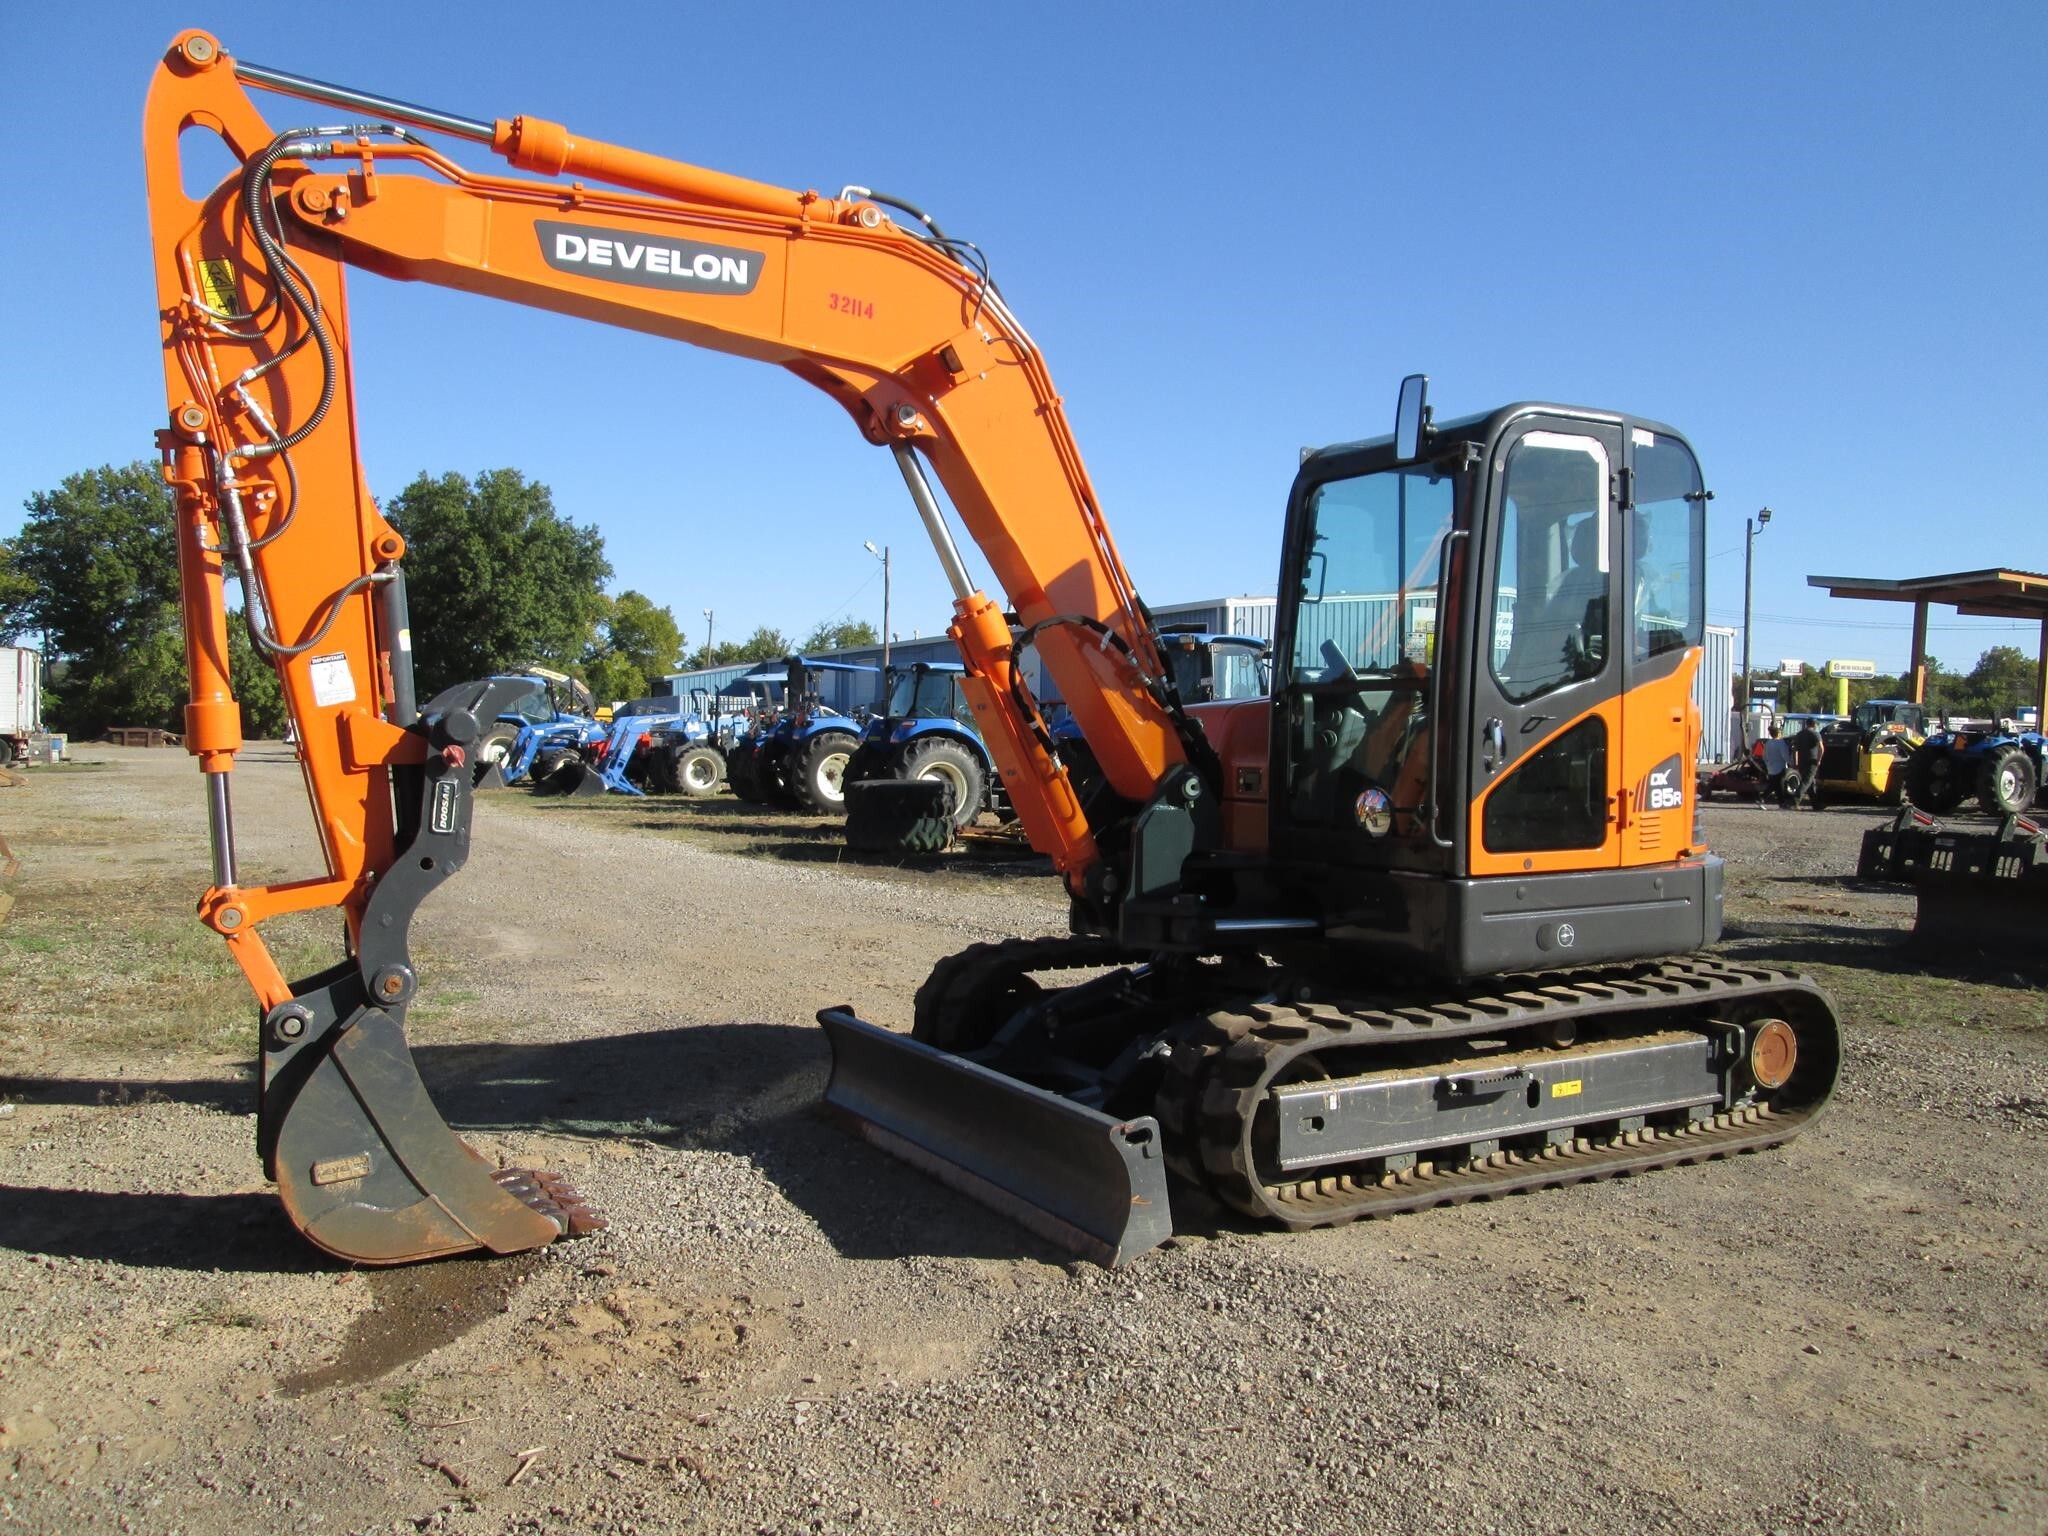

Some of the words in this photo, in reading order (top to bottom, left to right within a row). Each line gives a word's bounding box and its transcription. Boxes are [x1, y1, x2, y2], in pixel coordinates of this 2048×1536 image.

[555, 233, 748, 285] DEVELON
[829, 292, 873, 319] 32114
[312, 653, 346, 665] IMPORTANT
[439, 784, 451, 829] DOOSAN
[1651, 788, 1682, 808] 85R
